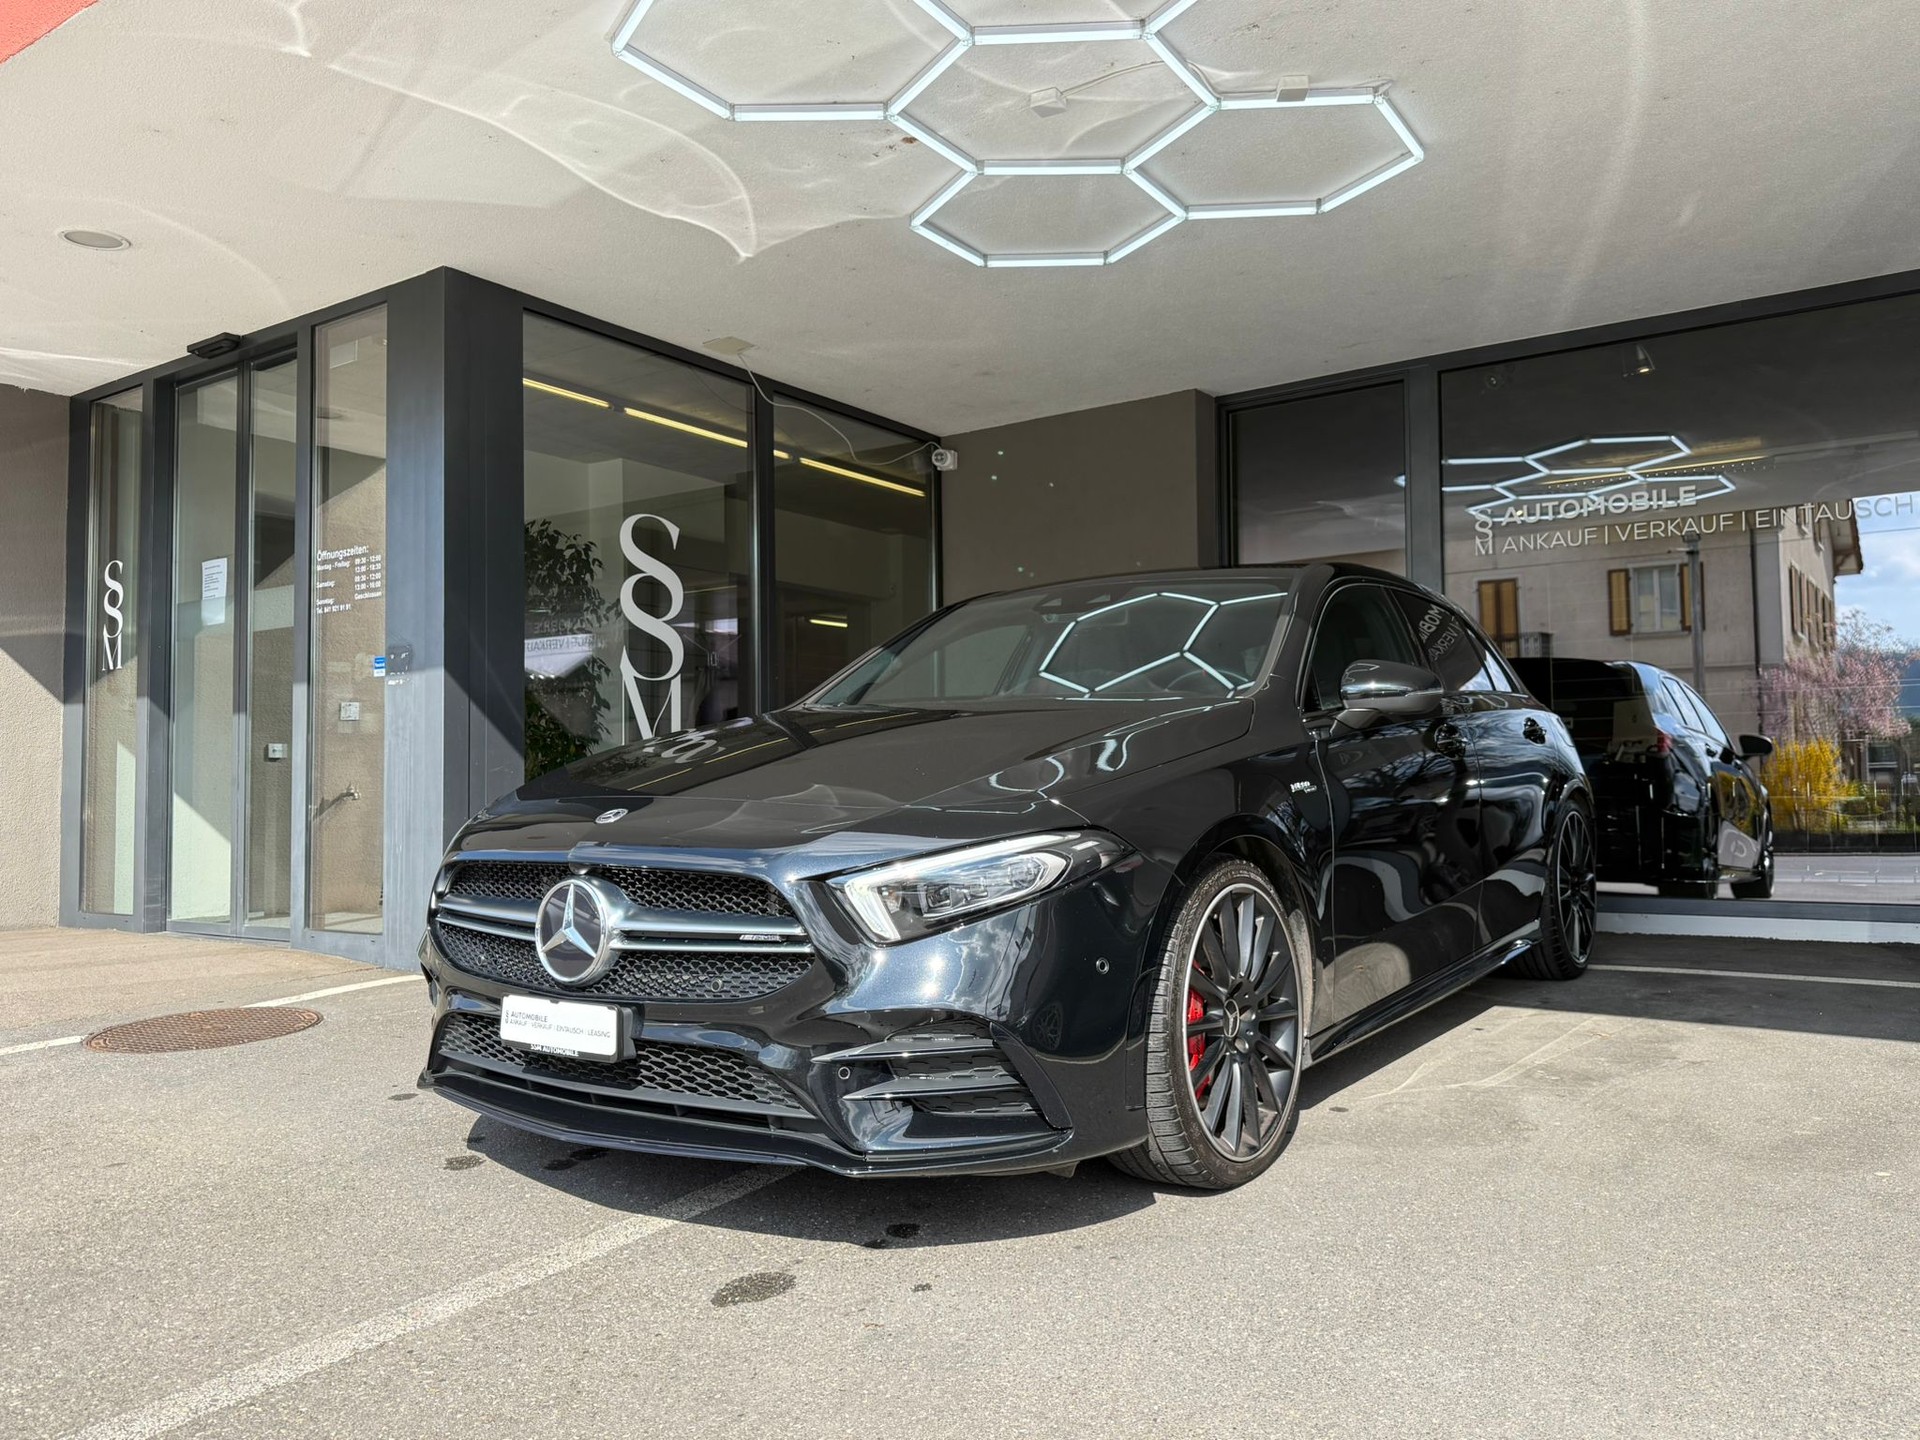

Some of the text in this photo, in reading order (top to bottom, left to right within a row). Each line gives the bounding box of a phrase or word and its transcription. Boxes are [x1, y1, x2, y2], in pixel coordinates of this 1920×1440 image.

[1501, 485, 1696, 526] AUTOMOBILE
[1501, 527, 1598, 553] ANKAUF
[1615, 513, 1734, 542] VERKAUF
[1755, 495, 1914, 529] EINTAUSCH
[316, 545, 369, 562] Öffnungszeiten:
[510, 1011, 548, 1023] AUTOMOBILE
[587, 1028, 611, 1038] LEASING
